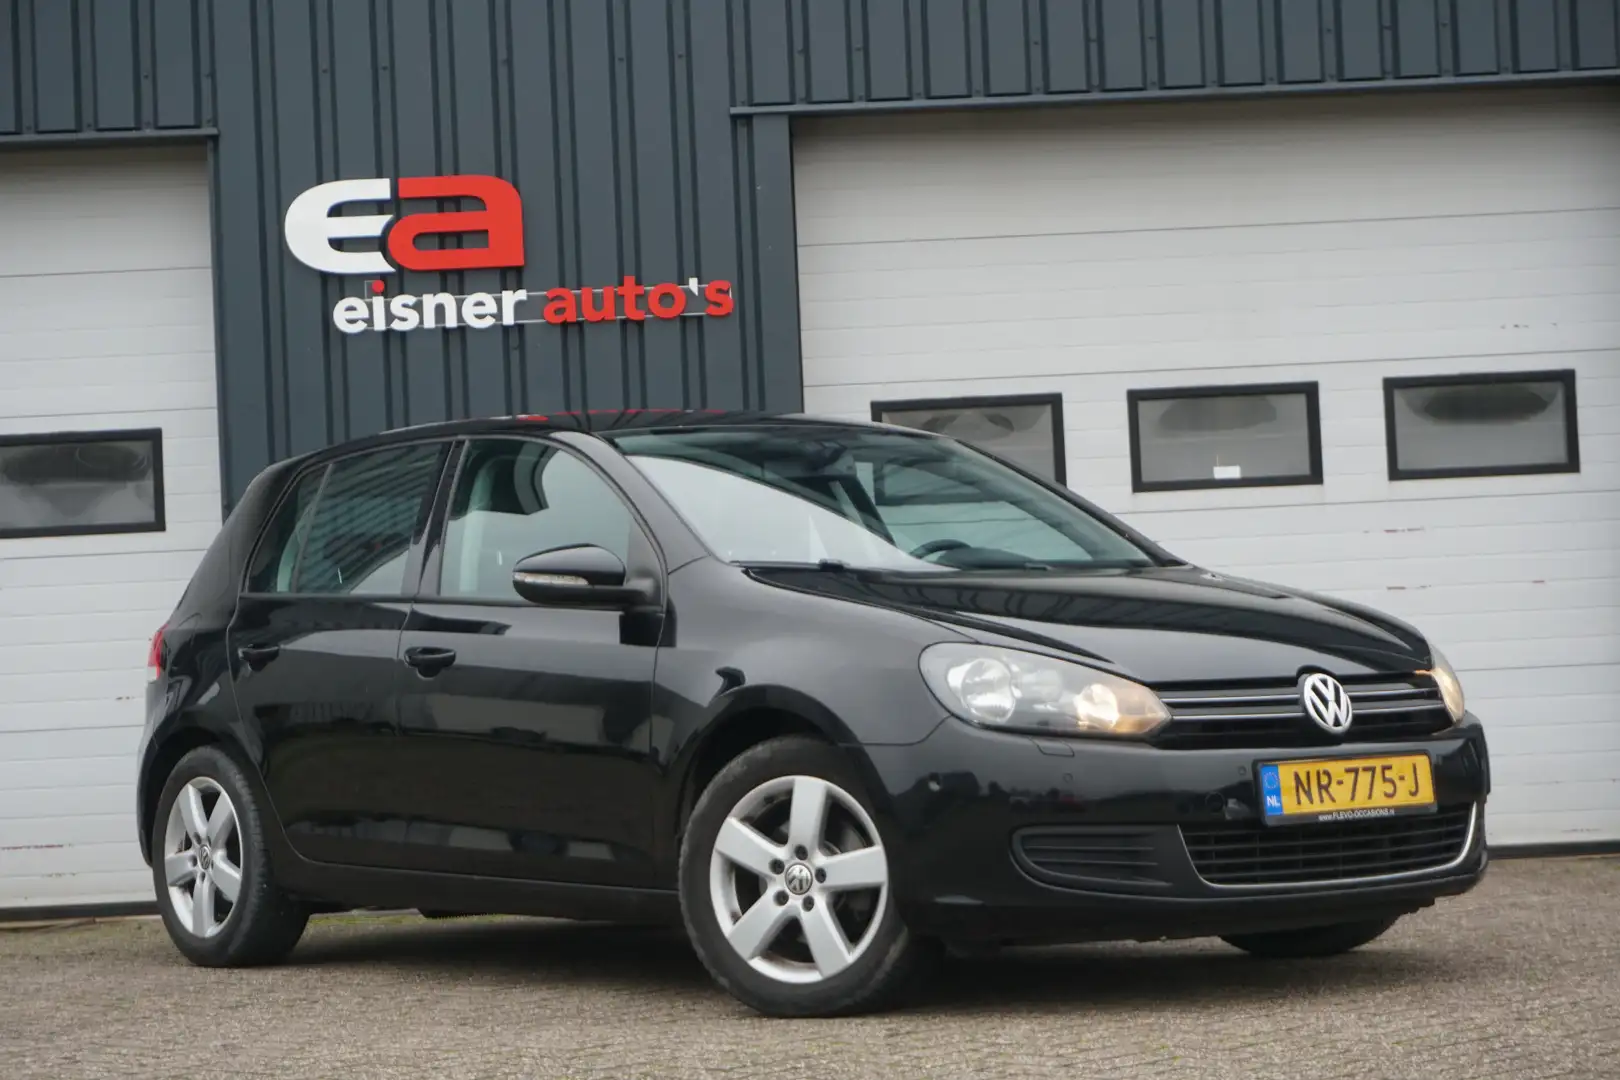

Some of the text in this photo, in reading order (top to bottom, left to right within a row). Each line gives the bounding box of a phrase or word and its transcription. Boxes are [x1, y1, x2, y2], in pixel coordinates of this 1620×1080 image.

[333, 275, 735, 334] eisner auto's
[1266, 795, 1281, 807] NL
[1293, 762, 1420, 806] NR-775-J
